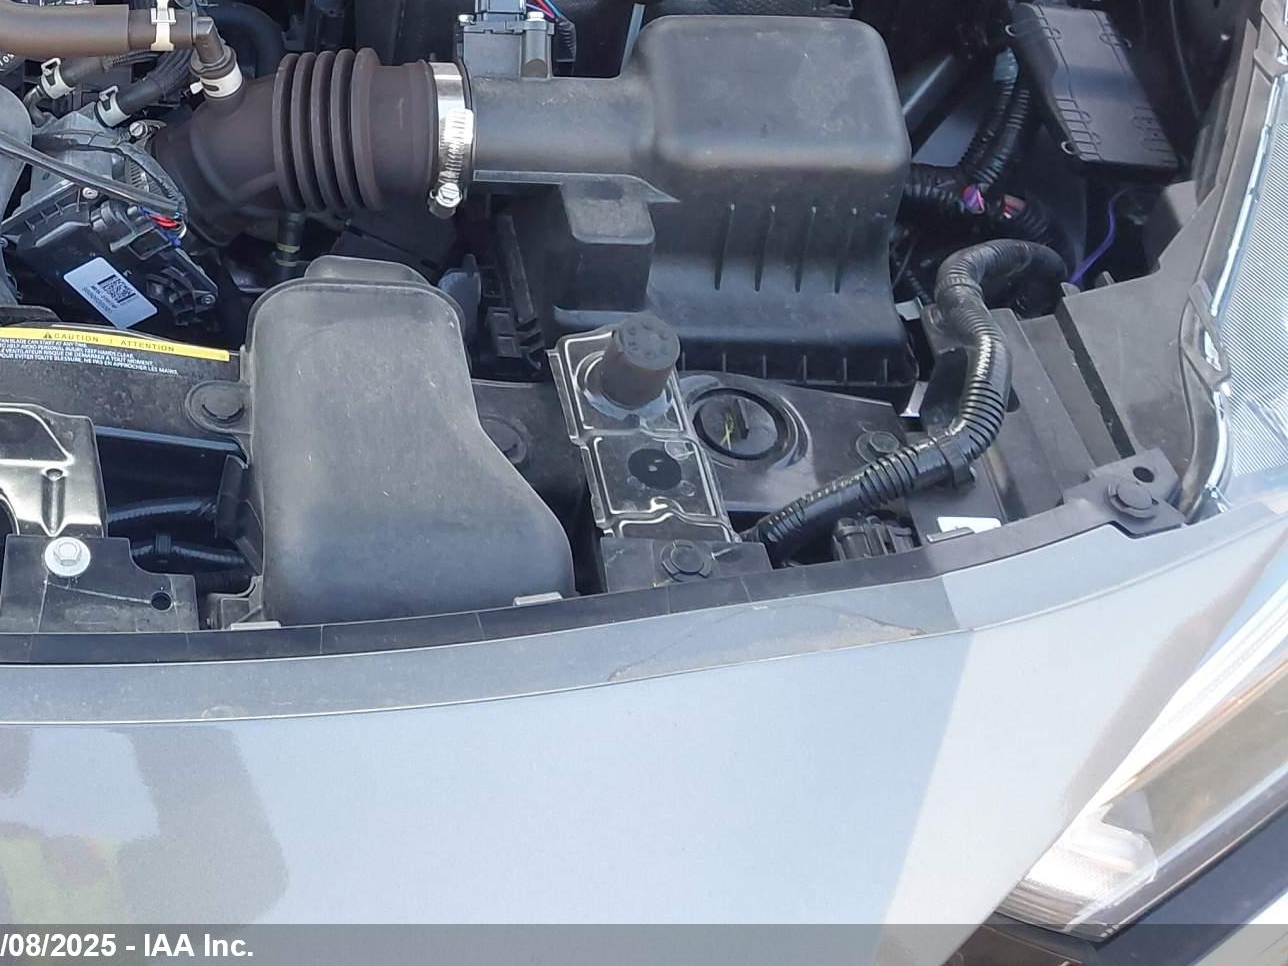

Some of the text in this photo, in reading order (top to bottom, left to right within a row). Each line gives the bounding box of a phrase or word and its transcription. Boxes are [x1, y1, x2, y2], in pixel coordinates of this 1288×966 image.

[54, 333, 99, 343] CAUTION
[121, 340, 175, 354] ATTENTION
[111, 355, 126, 363] TOUT
[113, 362, 147, 371] APPROCHER
